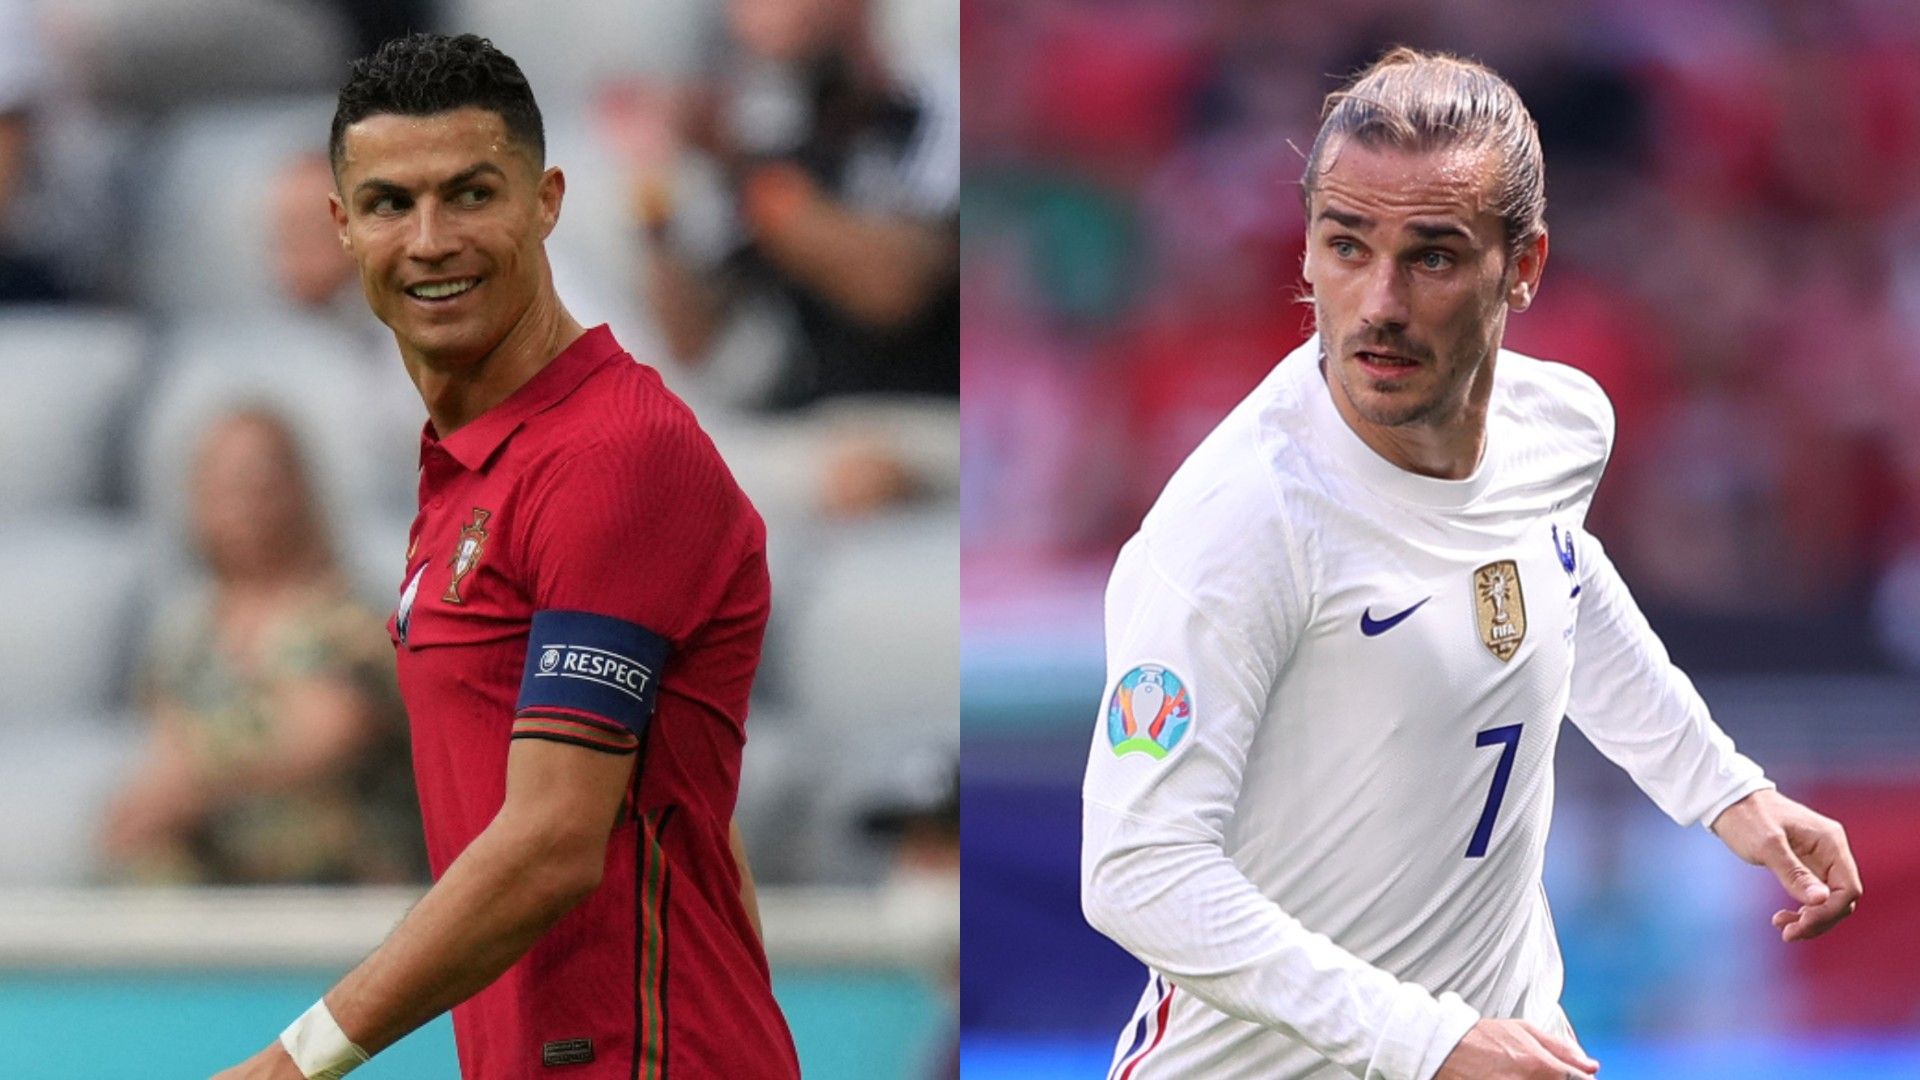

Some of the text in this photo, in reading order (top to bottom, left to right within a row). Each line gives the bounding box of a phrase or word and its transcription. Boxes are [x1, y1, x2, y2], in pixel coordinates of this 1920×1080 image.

[1492, 623, 1516, 640] FIFA
[563, 652, 649, 693] RESPECT
[1464, 722, 1524, 858] 7
